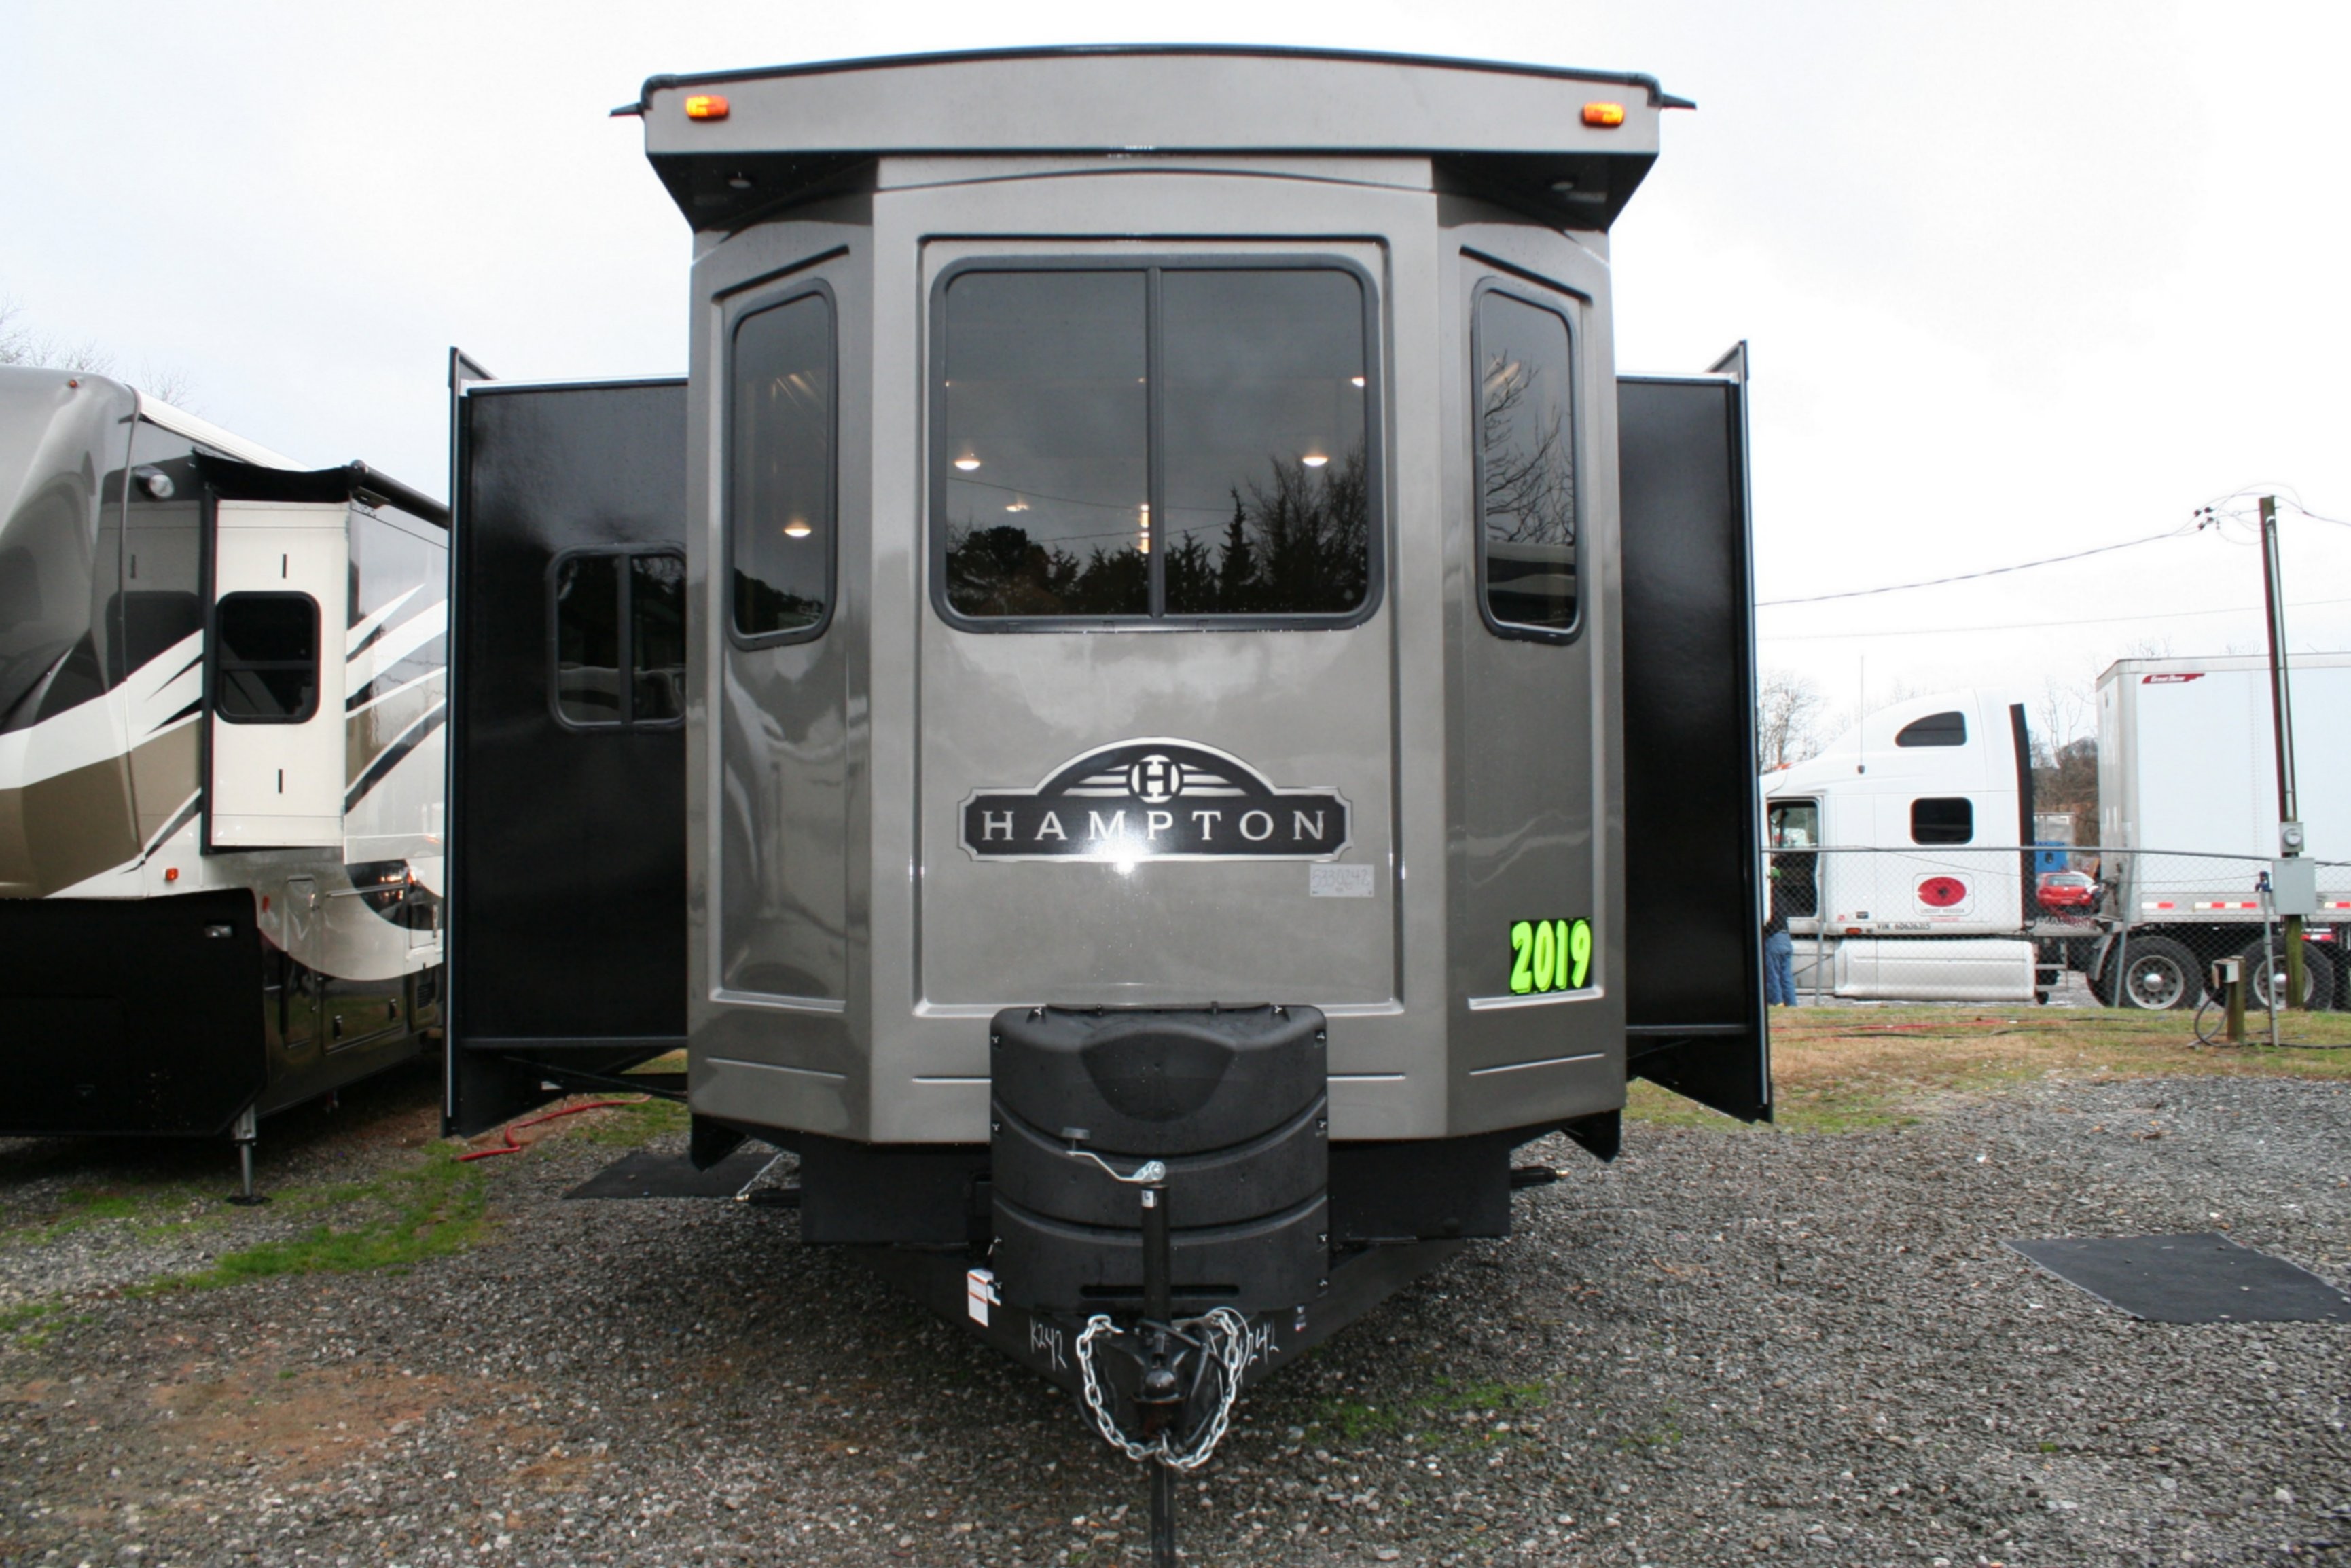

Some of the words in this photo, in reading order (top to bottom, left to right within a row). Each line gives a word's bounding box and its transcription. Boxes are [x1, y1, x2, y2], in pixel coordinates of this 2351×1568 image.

[1138, 761, 1172, 797] H
[982, 810, 1325, 840] HAMPTON
[1510, 919, 1592, 993] 2019
